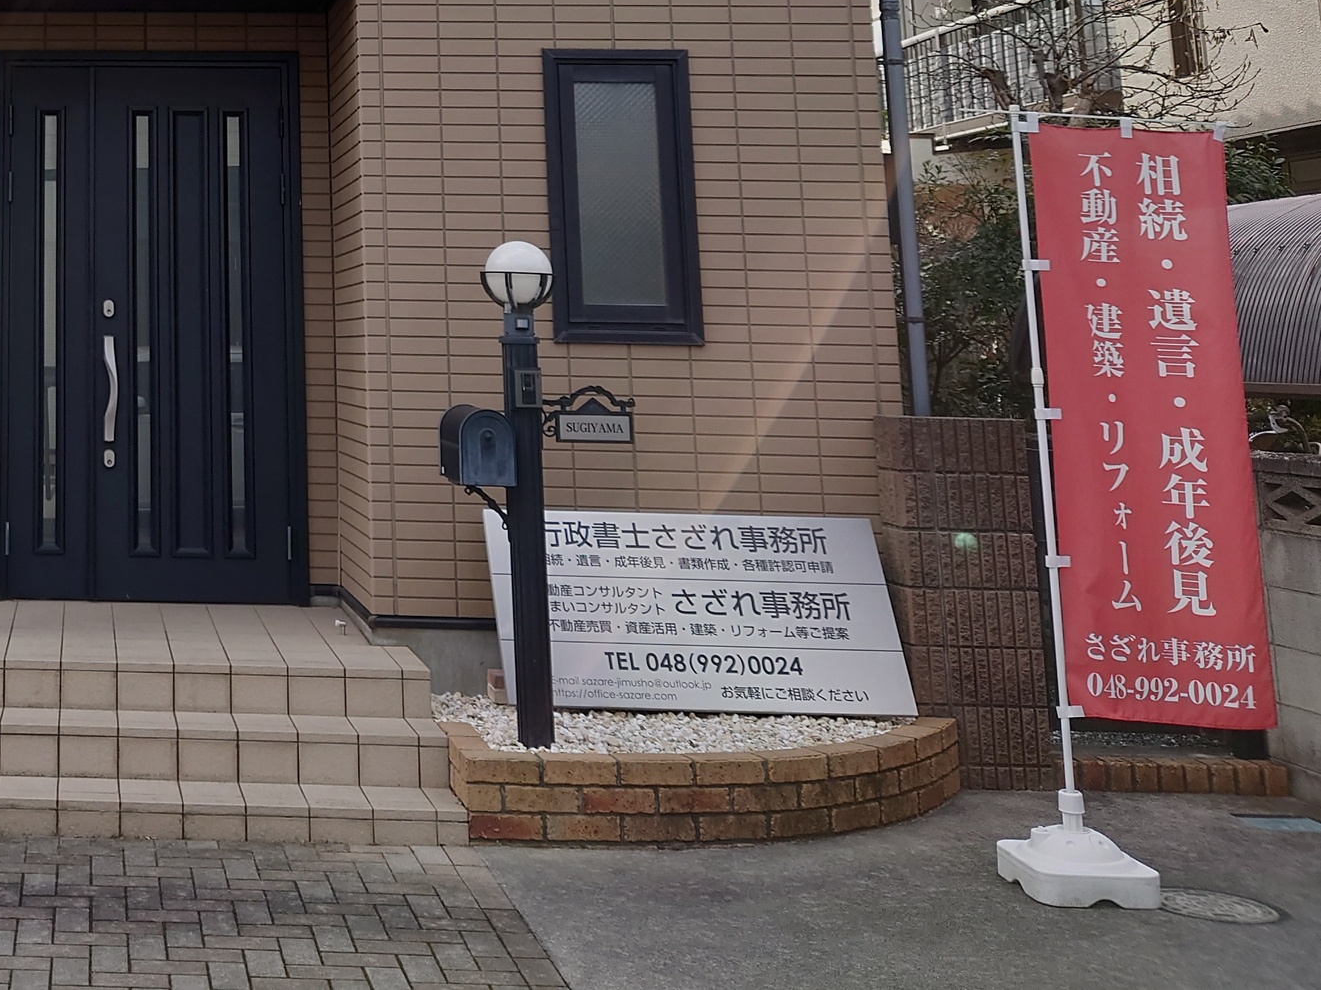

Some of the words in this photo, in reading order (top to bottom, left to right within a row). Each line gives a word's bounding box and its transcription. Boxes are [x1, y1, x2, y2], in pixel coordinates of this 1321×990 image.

[1077, 151, 1143, 613] 不動産・建築・リフォーム
[1135, 152, 1217, 618] 相続・遺言・成年後見
[565, 421, 625, 435] SUGIYAMA
[548, 583, 664, 600] 動産コンサルタント
[549, 600, 666, 616] まいコンサルタント
[671, 588, 852, 621] さざれ事務所
[548, 618, 851, 641] 不動産売買・資産活用・建築・リフォーム等ご提案
[604, 651, 641, 671] TEL
[645, 652, 804, 676] 048(992)0024
[1084, 631, 1257, 675] さざれ事務所
[581, 676, 713, 692] sazare-jimusho@outlook.jp
[720, 685, 870, 703] お気軽にご相談ください
[1086, 672, 1258, 710] 048-992-0024
